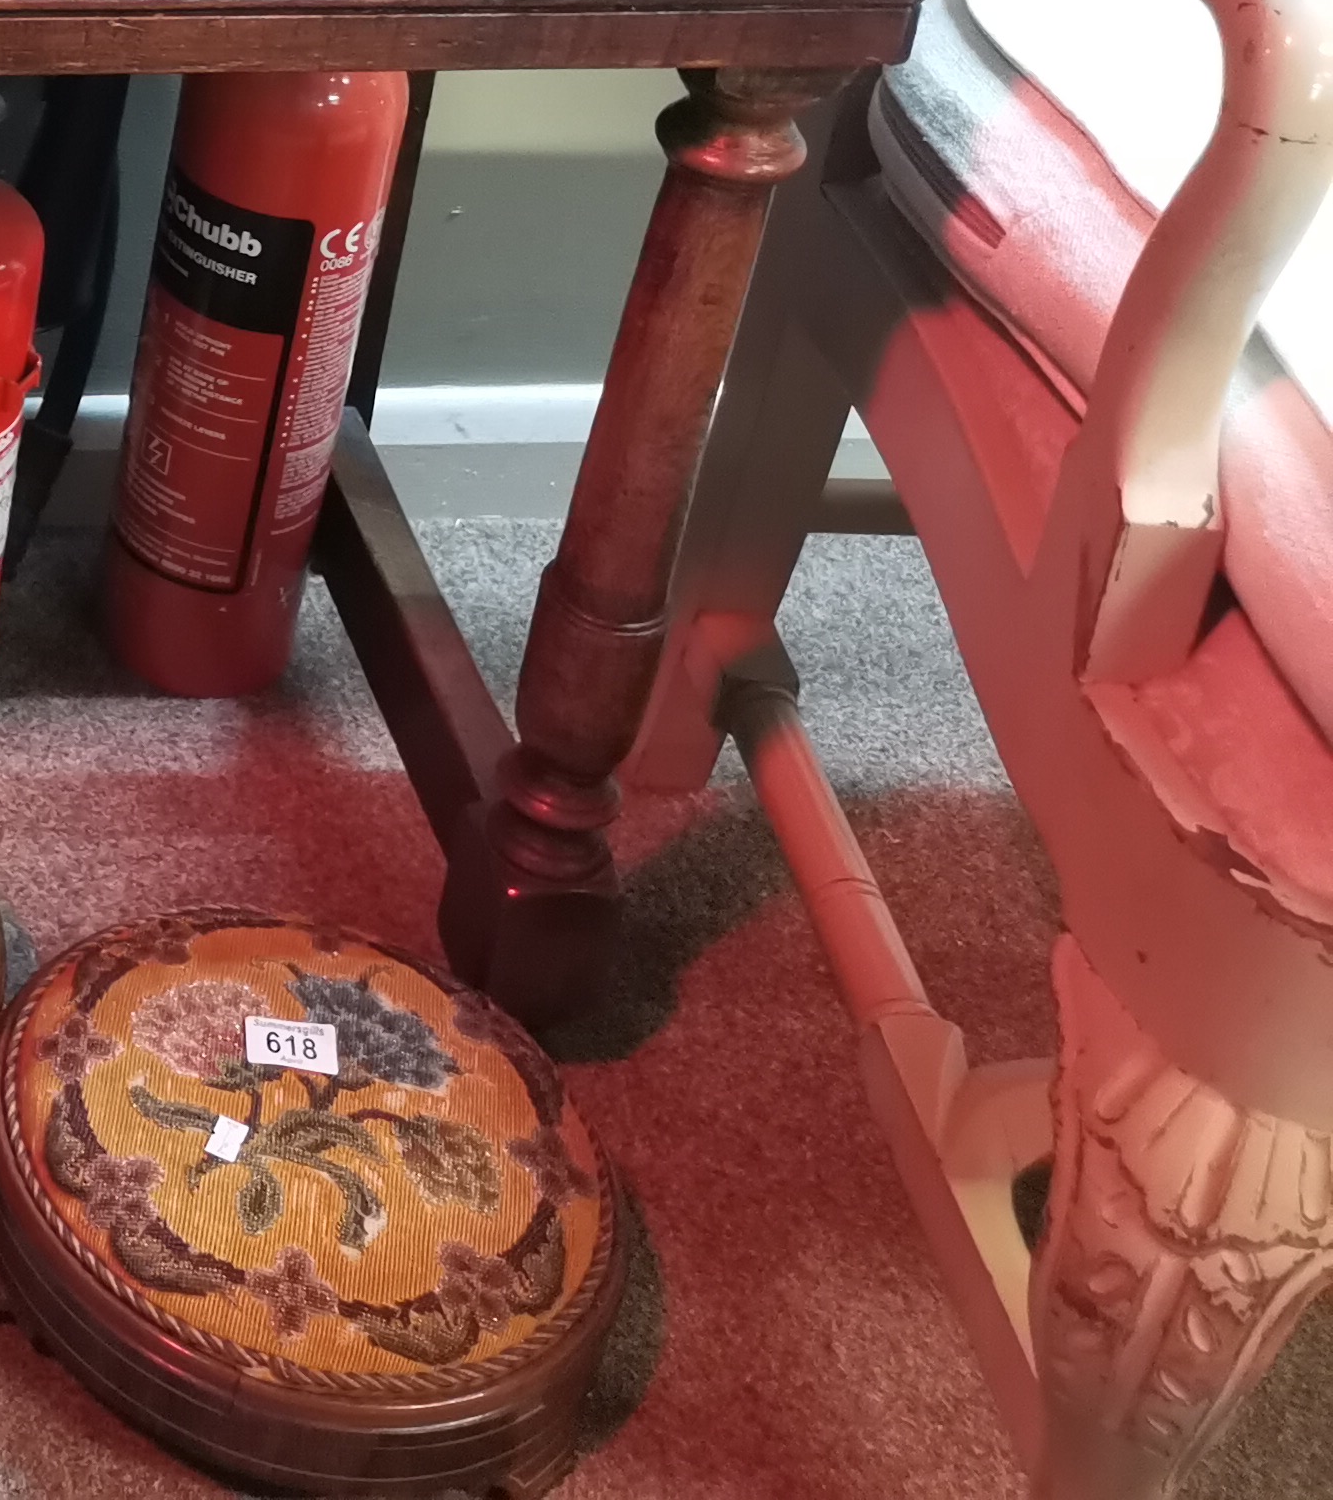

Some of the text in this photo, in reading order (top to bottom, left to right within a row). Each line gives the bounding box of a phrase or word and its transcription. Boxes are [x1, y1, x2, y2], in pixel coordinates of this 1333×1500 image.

[175, 194, 262, 257] Chubb
[319, 221, 364, 259] CE
[266, 1031, 317, 1060] 618
